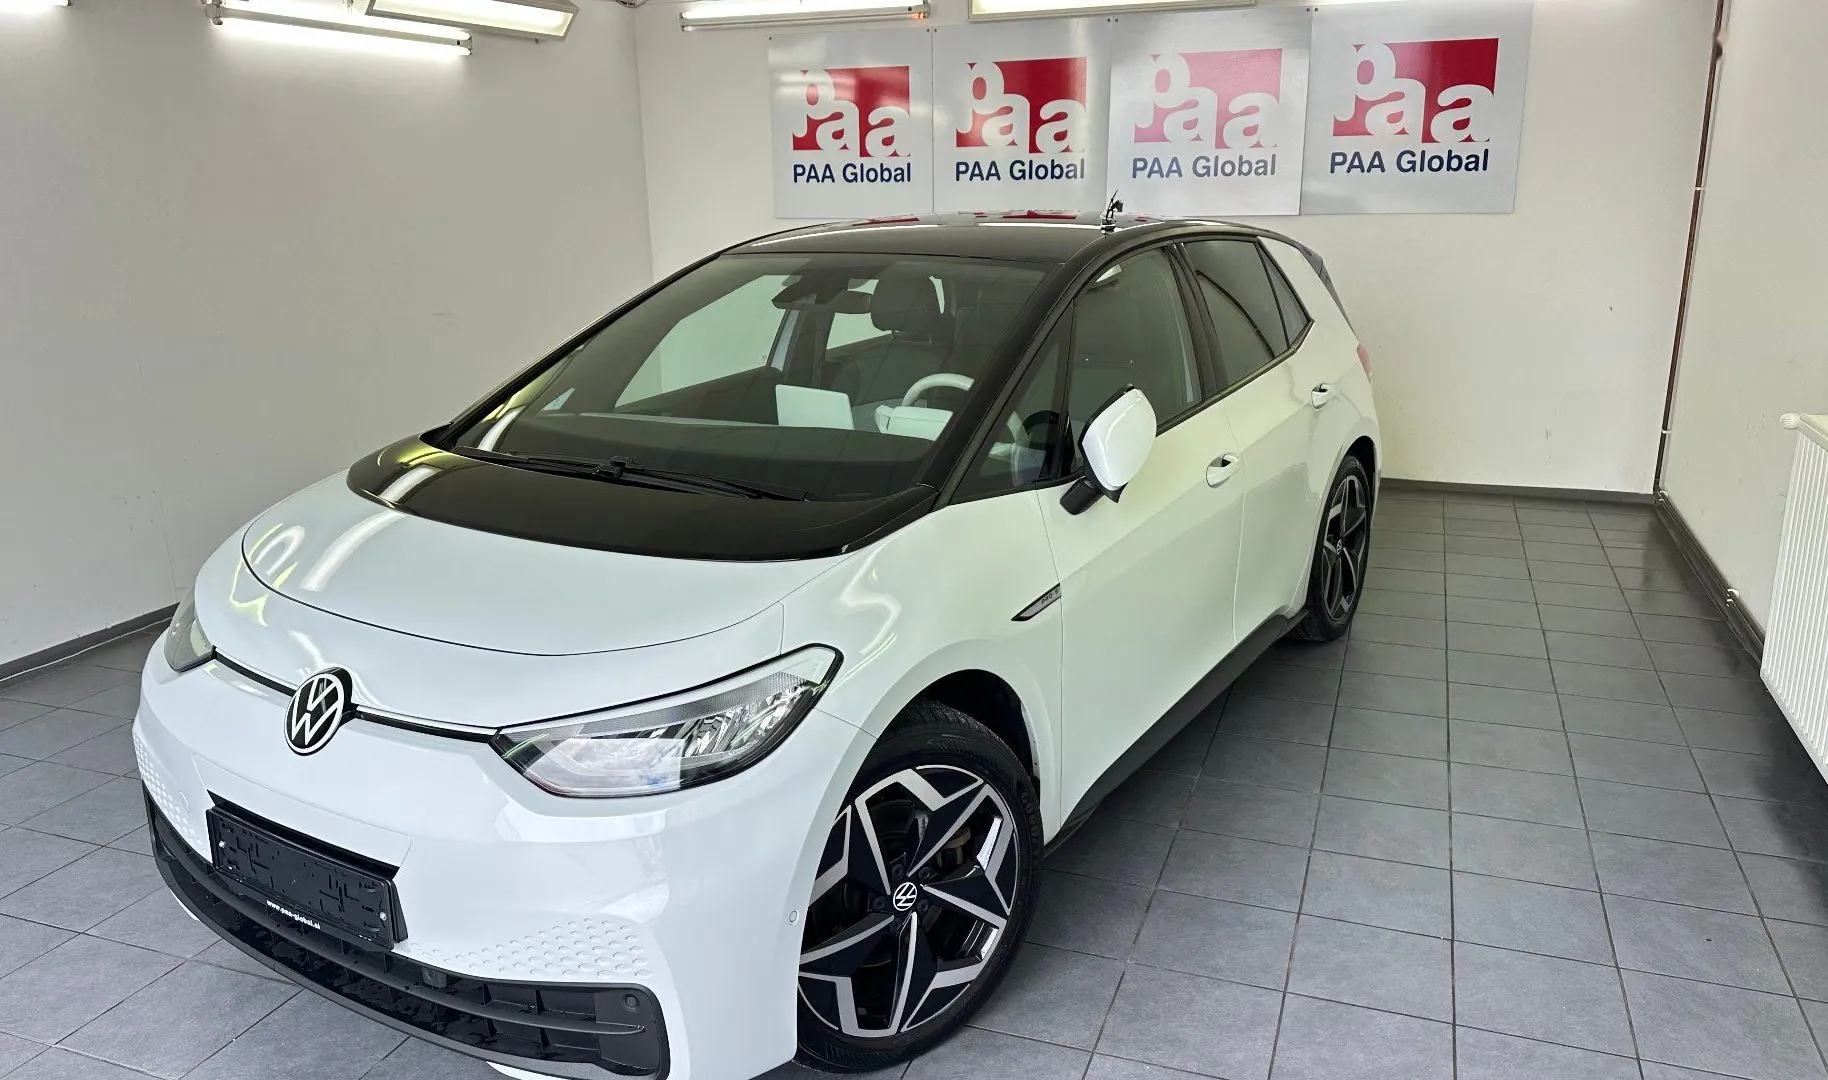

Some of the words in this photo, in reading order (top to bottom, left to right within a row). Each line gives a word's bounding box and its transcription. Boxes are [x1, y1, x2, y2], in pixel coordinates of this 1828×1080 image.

[793, 67, 910, 157] paa
[956, 61, 1086, 154] paa
[1134, 51, 1281, 149] paa
[1333, 43, 1495, 144] paa
[793, 163, 835, 184] PAA
[842, 162, 911, 183] Global
[955, 160, 1001, 182] PAA
[1009, 158, 1085, 181] Global
[1132, 156, 1183, 179] PAA
[1192, 153, 1277, 178] Global
[1329, 151, 1386, 174] PAA
[1396, 148, 1490, 173] Global
